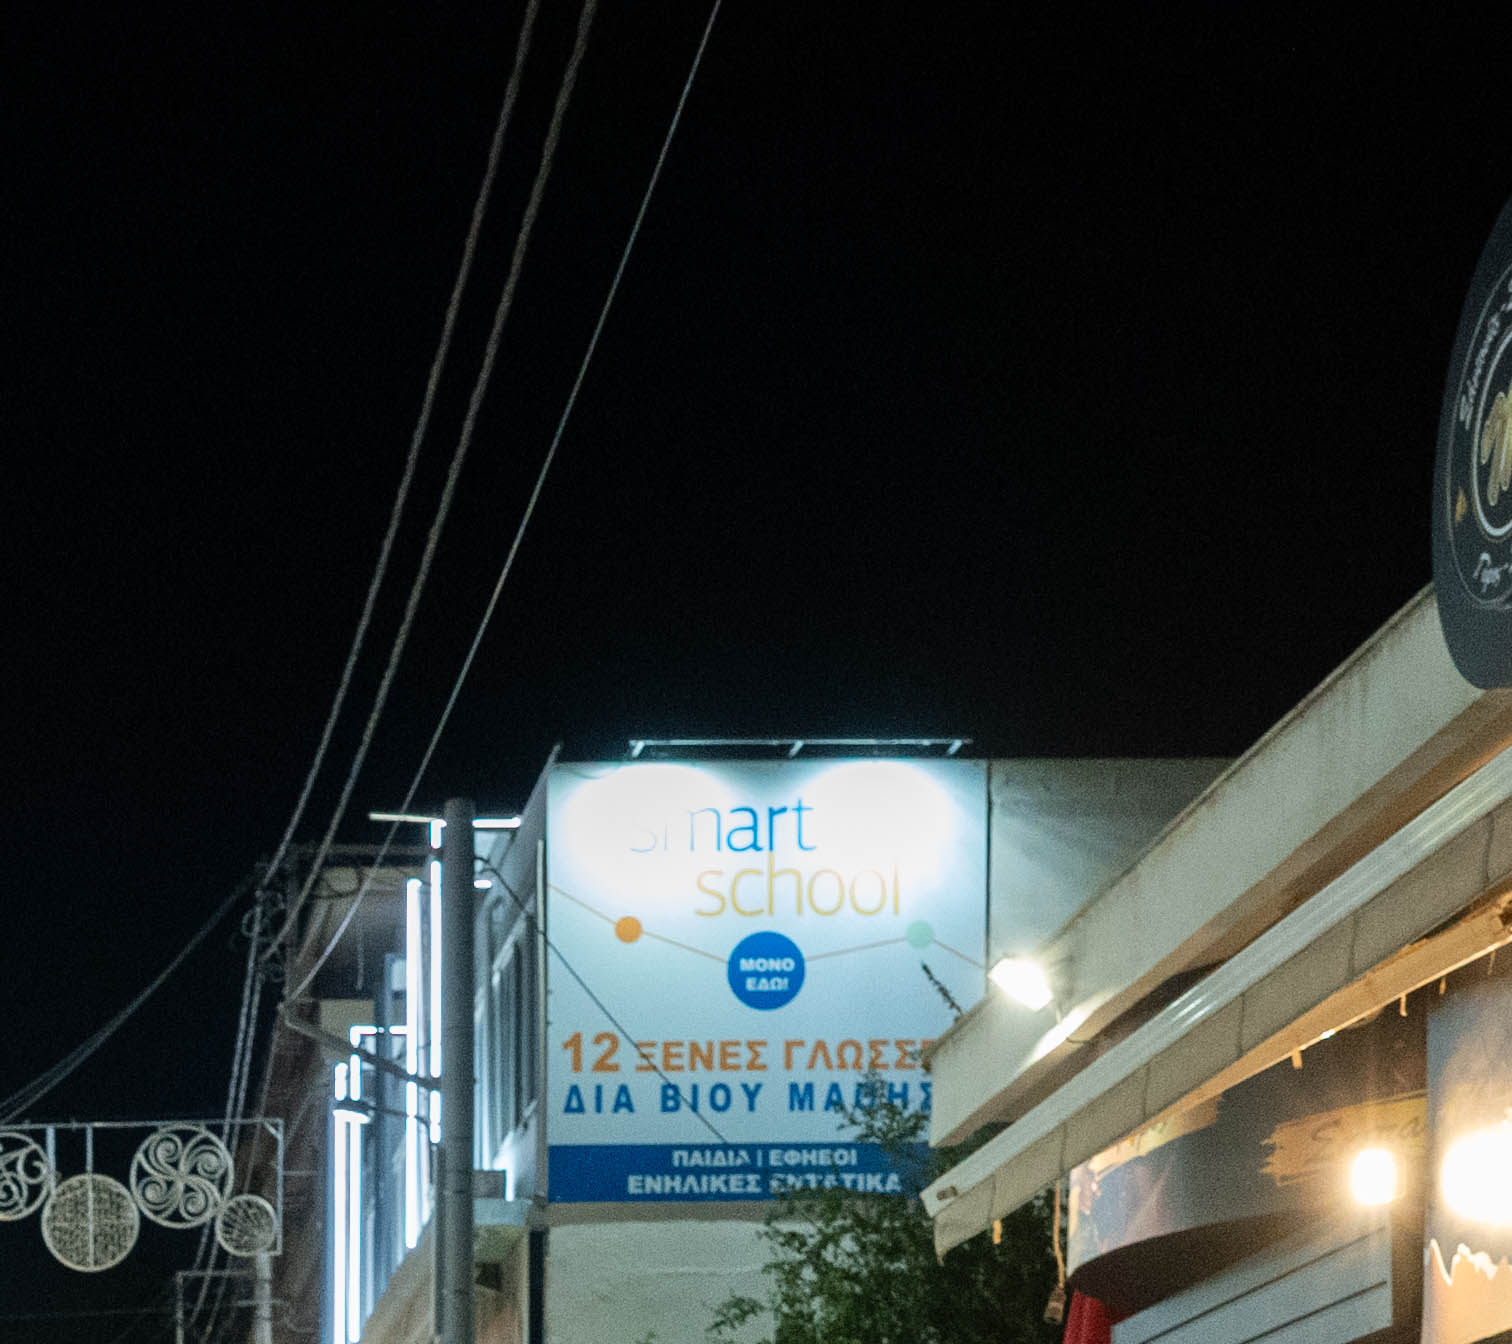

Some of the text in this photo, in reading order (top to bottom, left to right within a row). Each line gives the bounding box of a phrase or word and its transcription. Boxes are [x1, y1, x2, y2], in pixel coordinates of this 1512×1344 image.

[694, 850, 901, 917] school
[562, 1031, 621, 1074] 12
[635, 1040, 769, 1073] ΞΕΝΕΣ
[562, 1083, 635, 1115] ΔΙΑ
[660, 1082, 764, 1114] ΒΙΟΥ
